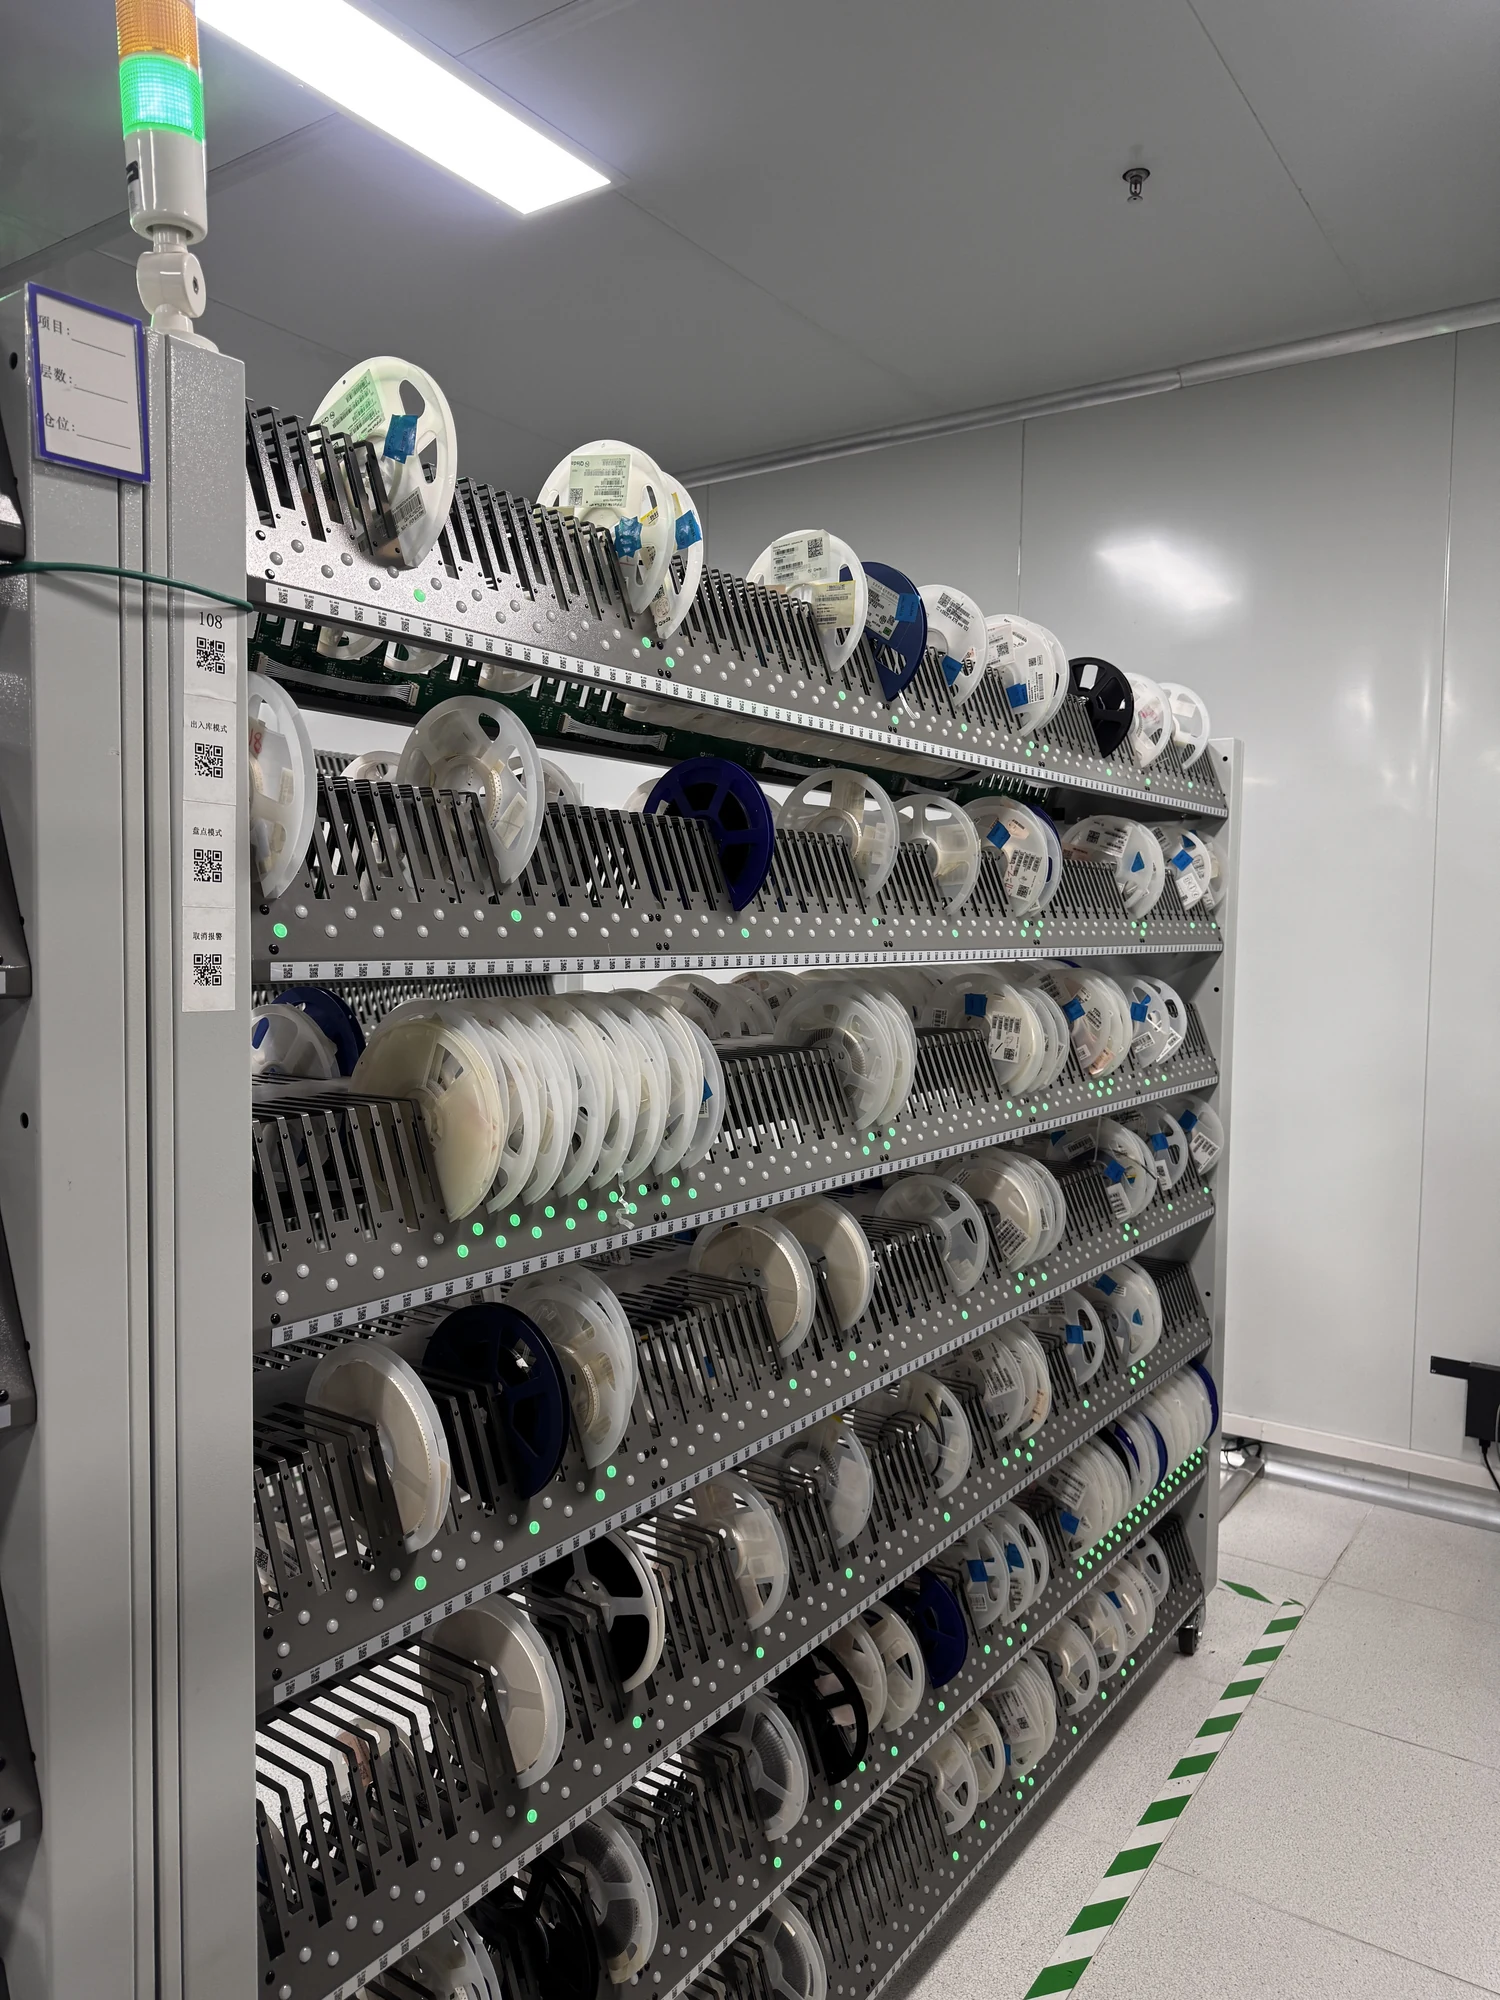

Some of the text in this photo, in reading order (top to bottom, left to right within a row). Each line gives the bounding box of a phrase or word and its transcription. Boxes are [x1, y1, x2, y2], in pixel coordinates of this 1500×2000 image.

[198, 611, 223, 630] 108
[190, 720, 228, 734] 出入库模式
[192, 826, 223, 838] 盘点模式
[192, 931, 223, 941] 取消报警
